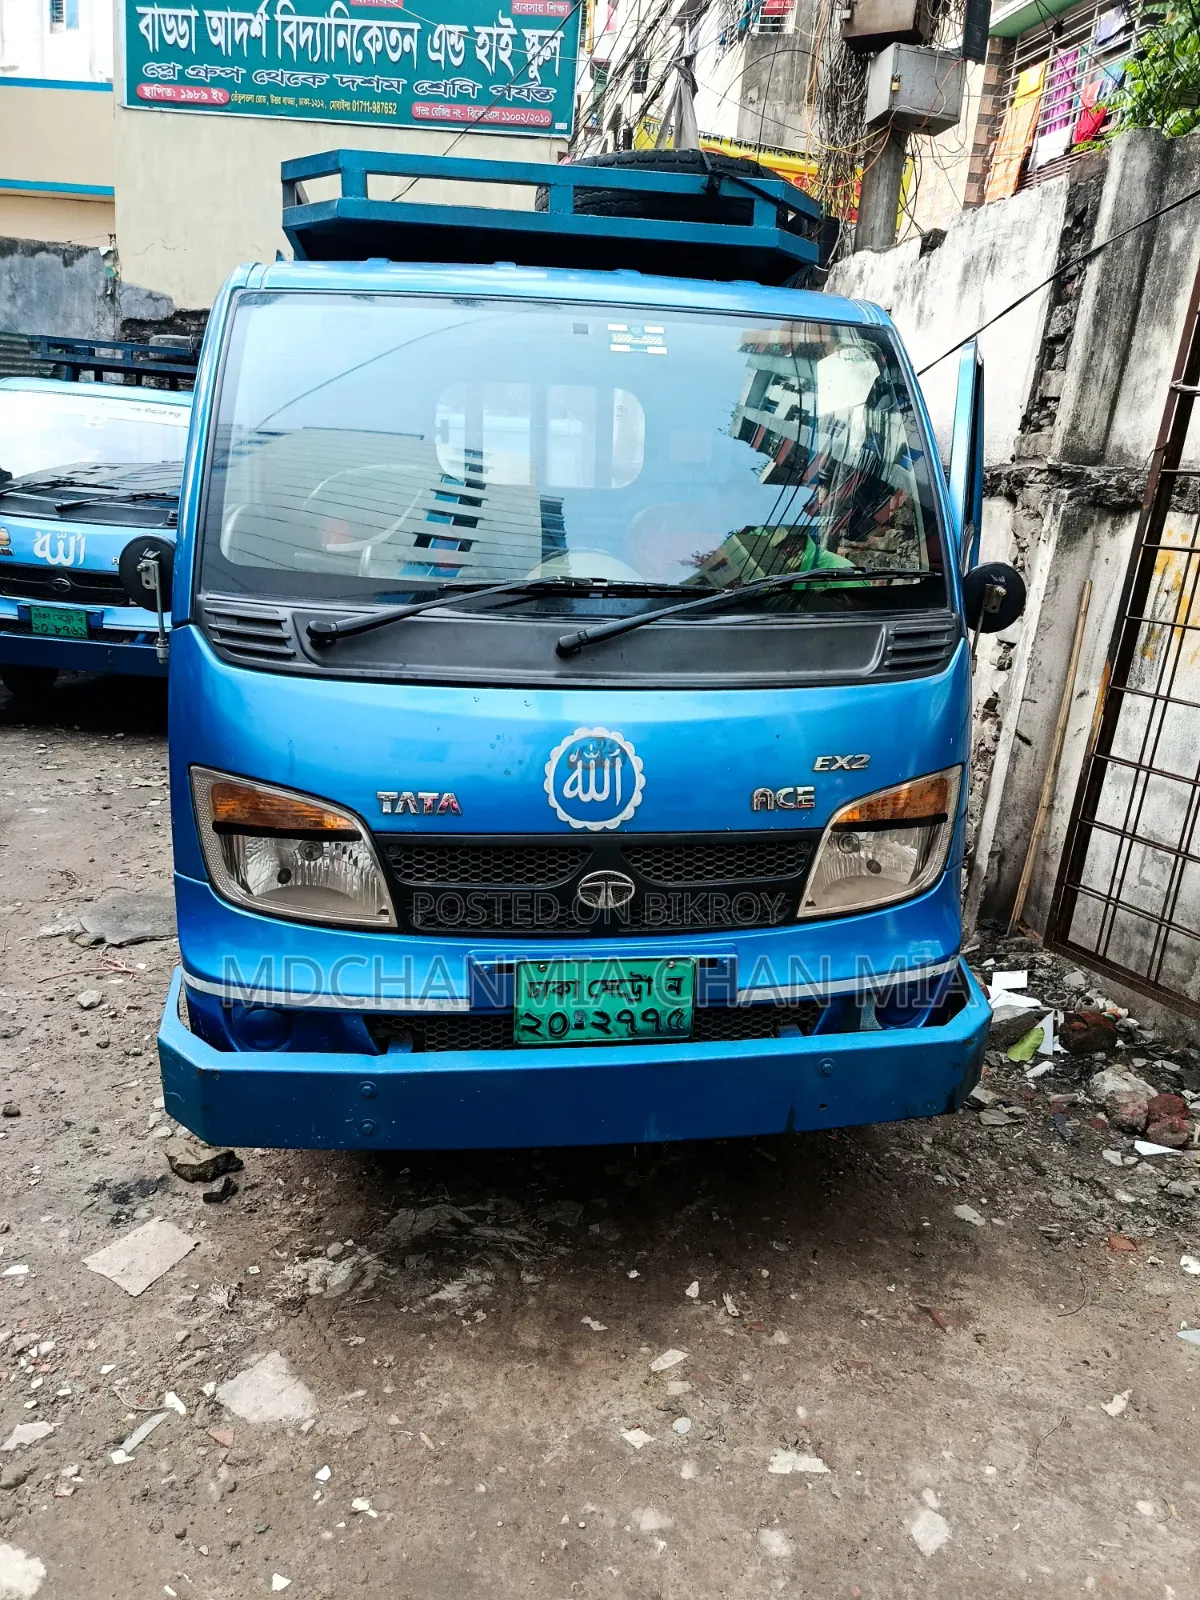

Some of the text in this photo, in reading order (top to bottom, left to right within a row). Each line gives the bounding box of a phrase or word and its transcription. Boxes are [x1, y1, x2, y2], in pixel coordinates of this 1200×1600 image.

[547, 2, 569, 14] শিক্ষা
[136, 0, 566, 82] বাড্ডা আদর্শ বিদ্যানিকেতন এন্ড হাই স্কুল
[143, 62, 557, 103] প্লে গ্রুপ থেকে দশম শ্রেণি পর্যন্ত
[180, 88, 208, 101] ১৯৮৯
[210, 88, 223, 102] ইং
[352, 100, 397, 114] 01711-987652
[812, 753, 872, 773] EX2
[376, 790, 463, 815] TATA
[752, 786, 817, 812] ACE
[527, 978, 581, 999] ঢাকা
[588, 971, 654, 1004] মেট্রো
